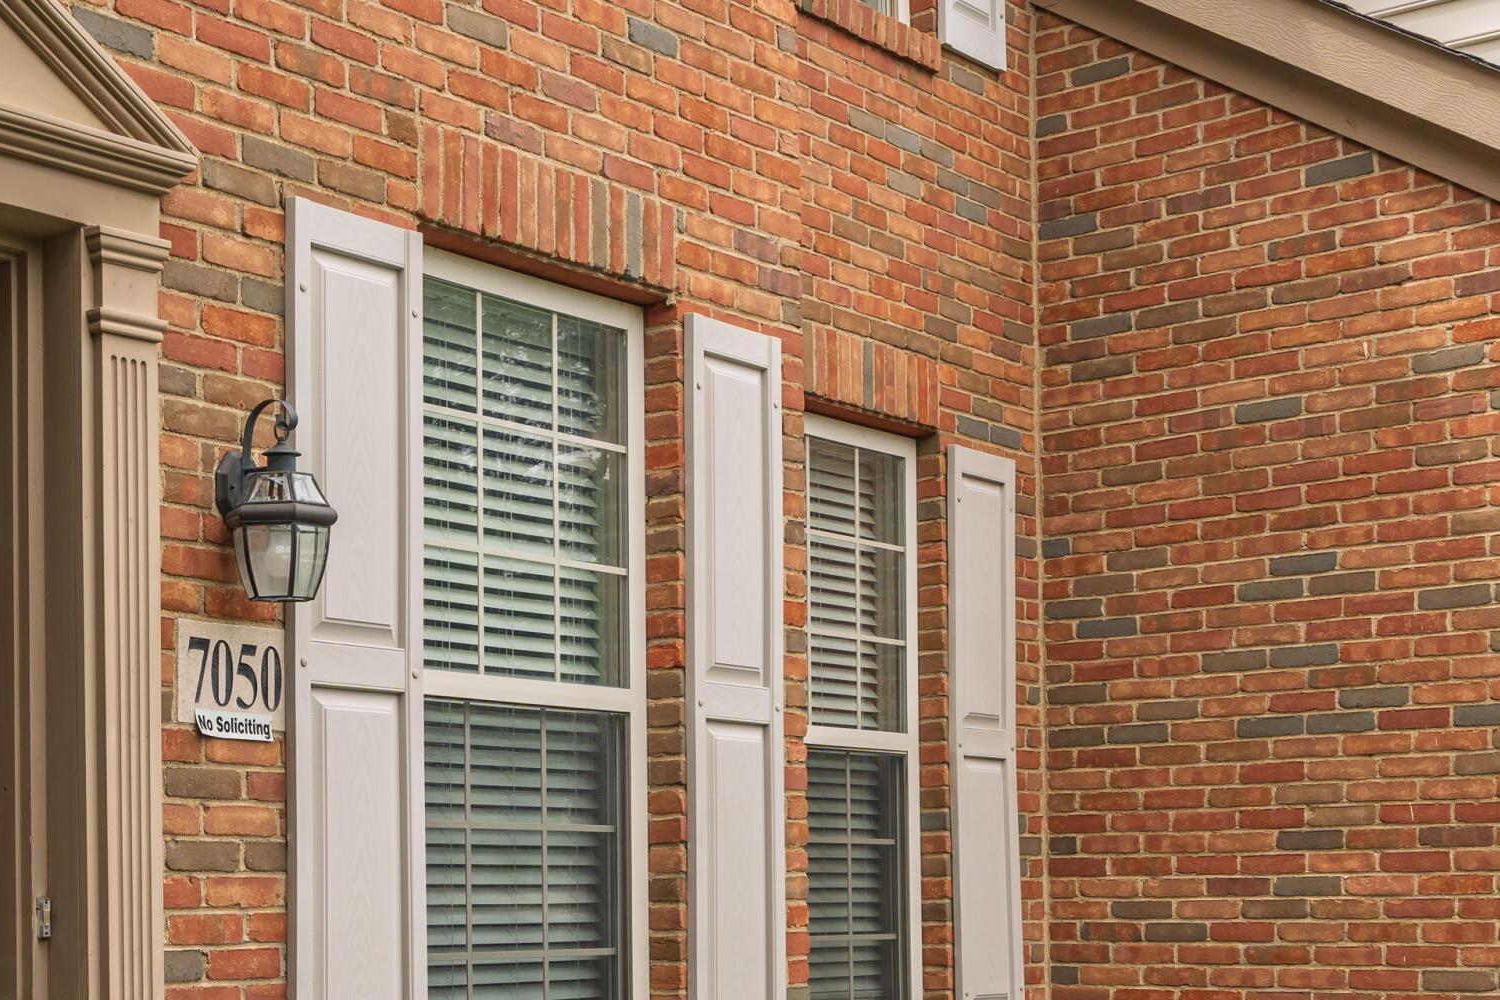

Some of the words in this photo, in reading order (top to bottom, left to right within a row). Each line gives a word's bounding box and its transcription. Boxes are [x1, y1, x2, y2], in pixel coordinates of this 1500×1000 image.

[188, 636, 282, 712] 7050
[198, 714, 213, 731] No
[216, 716, 271, 739] Soliciting
